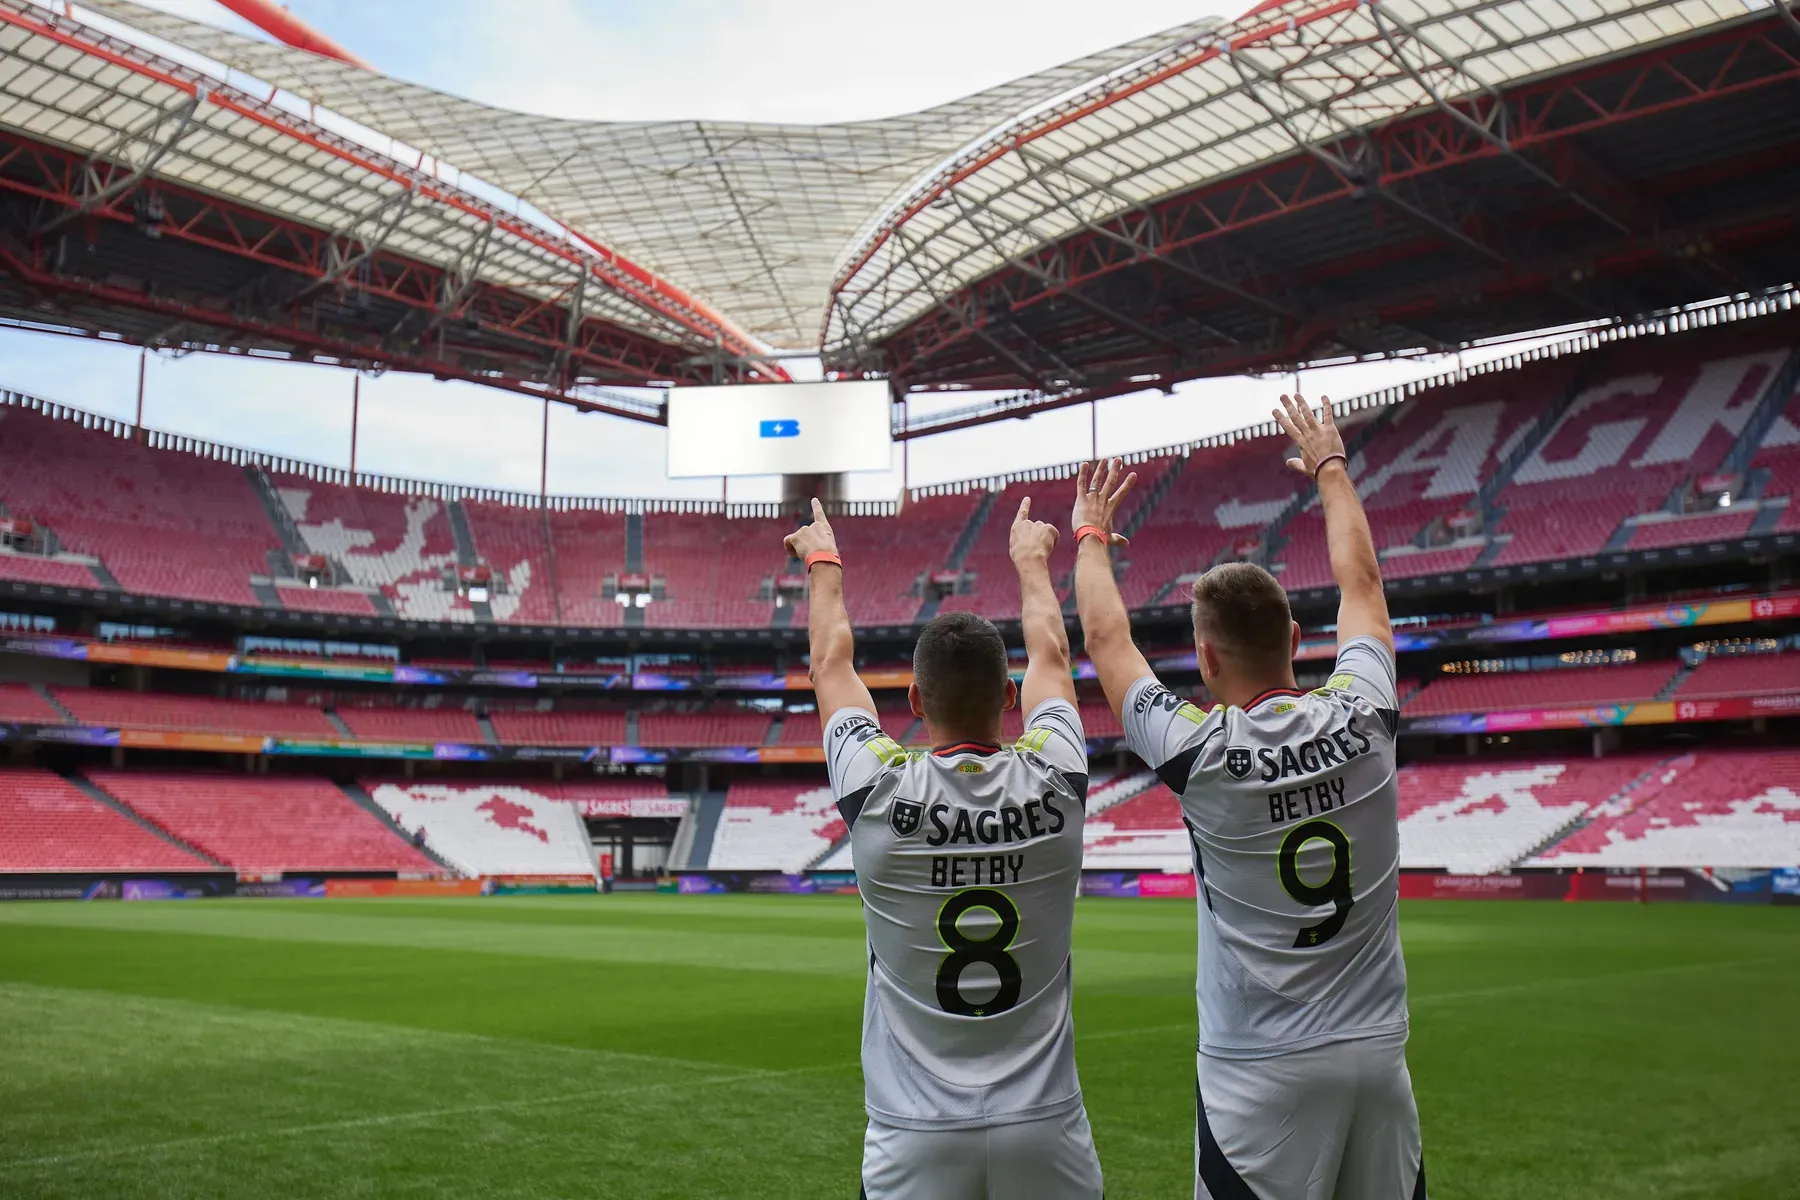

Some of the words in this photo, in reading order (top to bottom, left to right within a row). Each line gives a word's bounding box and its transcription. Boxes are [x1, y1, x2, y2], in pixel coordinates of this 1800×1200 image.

[1257, 717, 1371, 782] SAGRES
[926, 790, 1065, 846] SAGRES
[1268, 776, 1346, 823] BETBY
[931, 854, 1024, 887] BETBY
[1276, 819, 1355, 948] 9
[936, 887, 1022, 1017] 8
